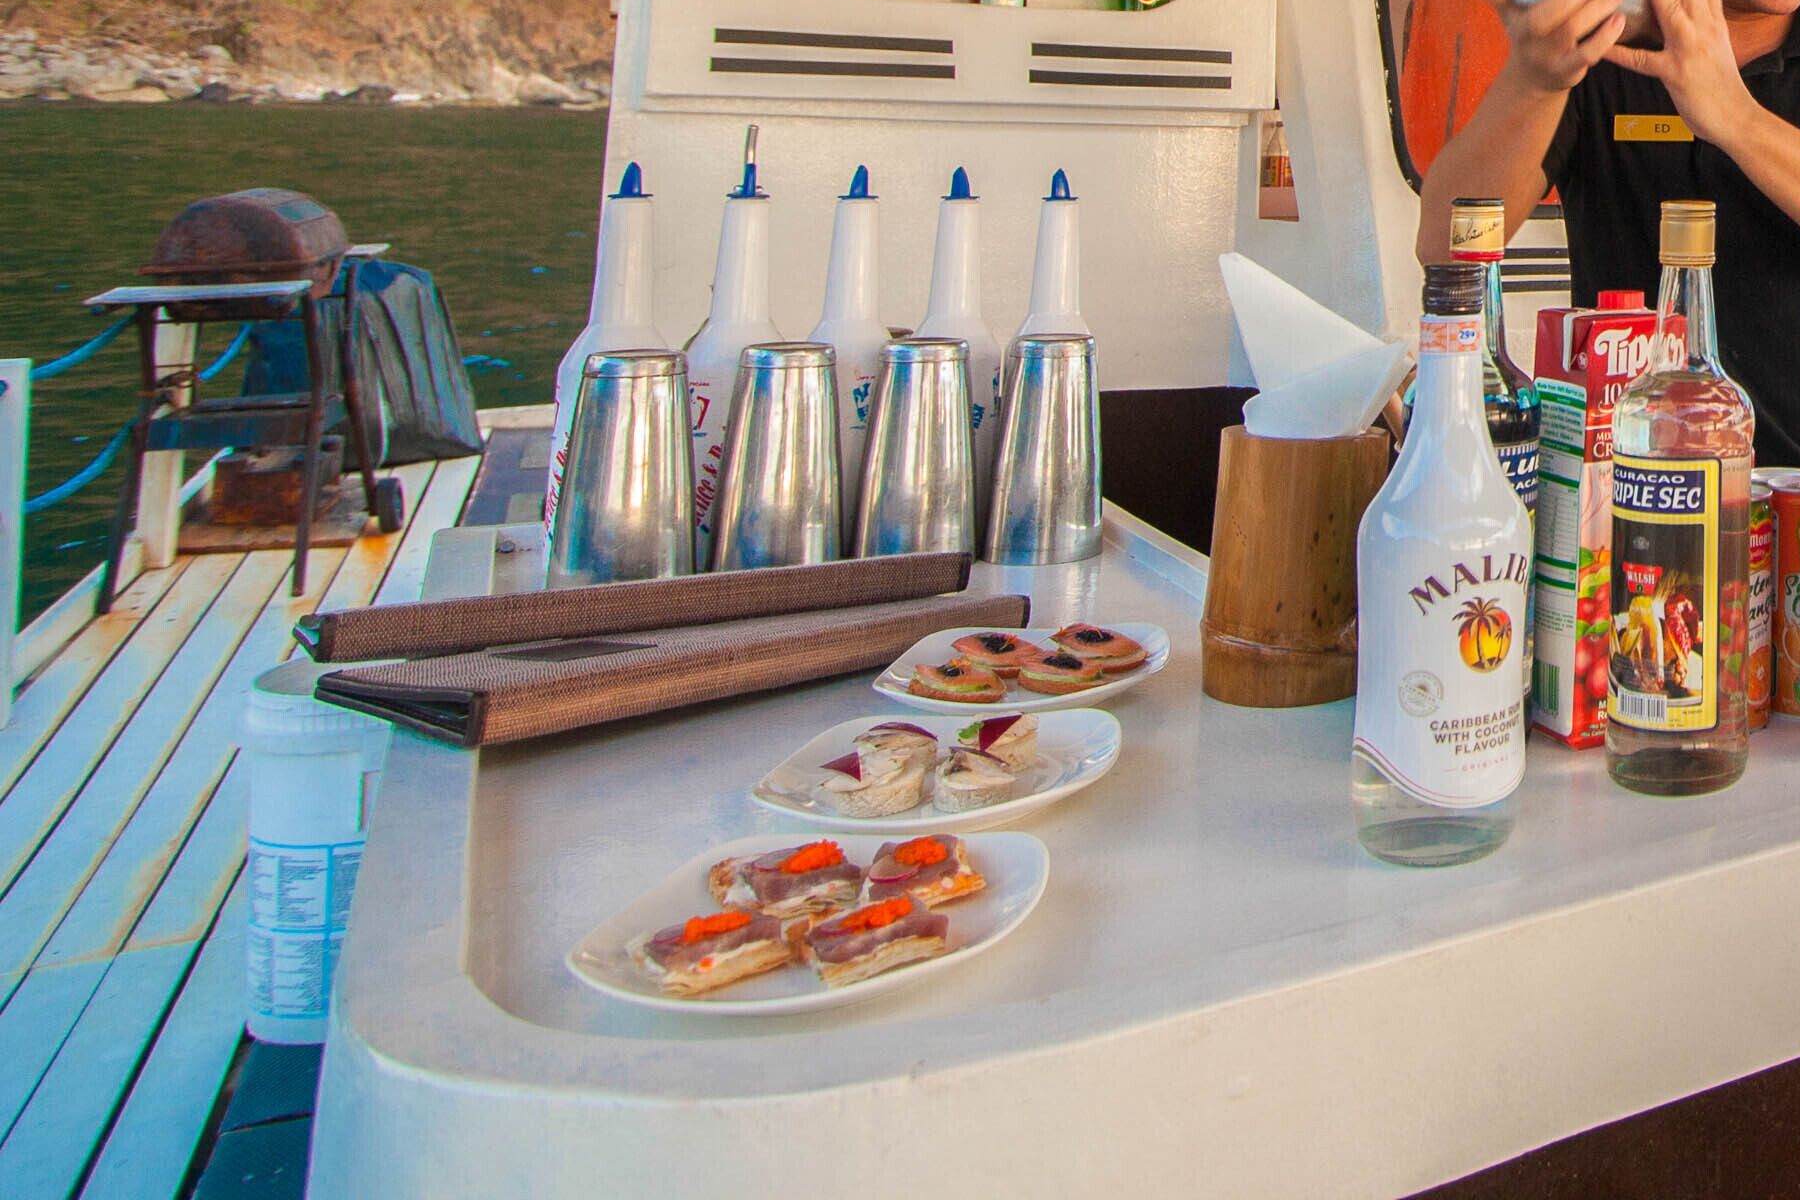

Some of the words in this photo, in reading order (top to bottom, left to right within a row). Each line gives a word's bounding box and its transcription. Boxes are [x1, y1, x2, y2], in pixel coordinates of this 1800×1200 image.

[1654, 123, 1671, 134] ED
[1614, 468, 1686, 484] CURACAO
[1613, 479, 1655, 508] RIPLE
[1657, 486, 1702, 510] SEC
[1408, 552, 1528, 617] MALIB
[1627, 571, 1656, 585] WALSH
[1429, 709, 1506, 732] CARIBBEAN
[1434, 730, 1470, 745] WITH
[1474, 712, 1520, 739] COCONUT
[1455, 732, 1511, 756] FLAVOUR
